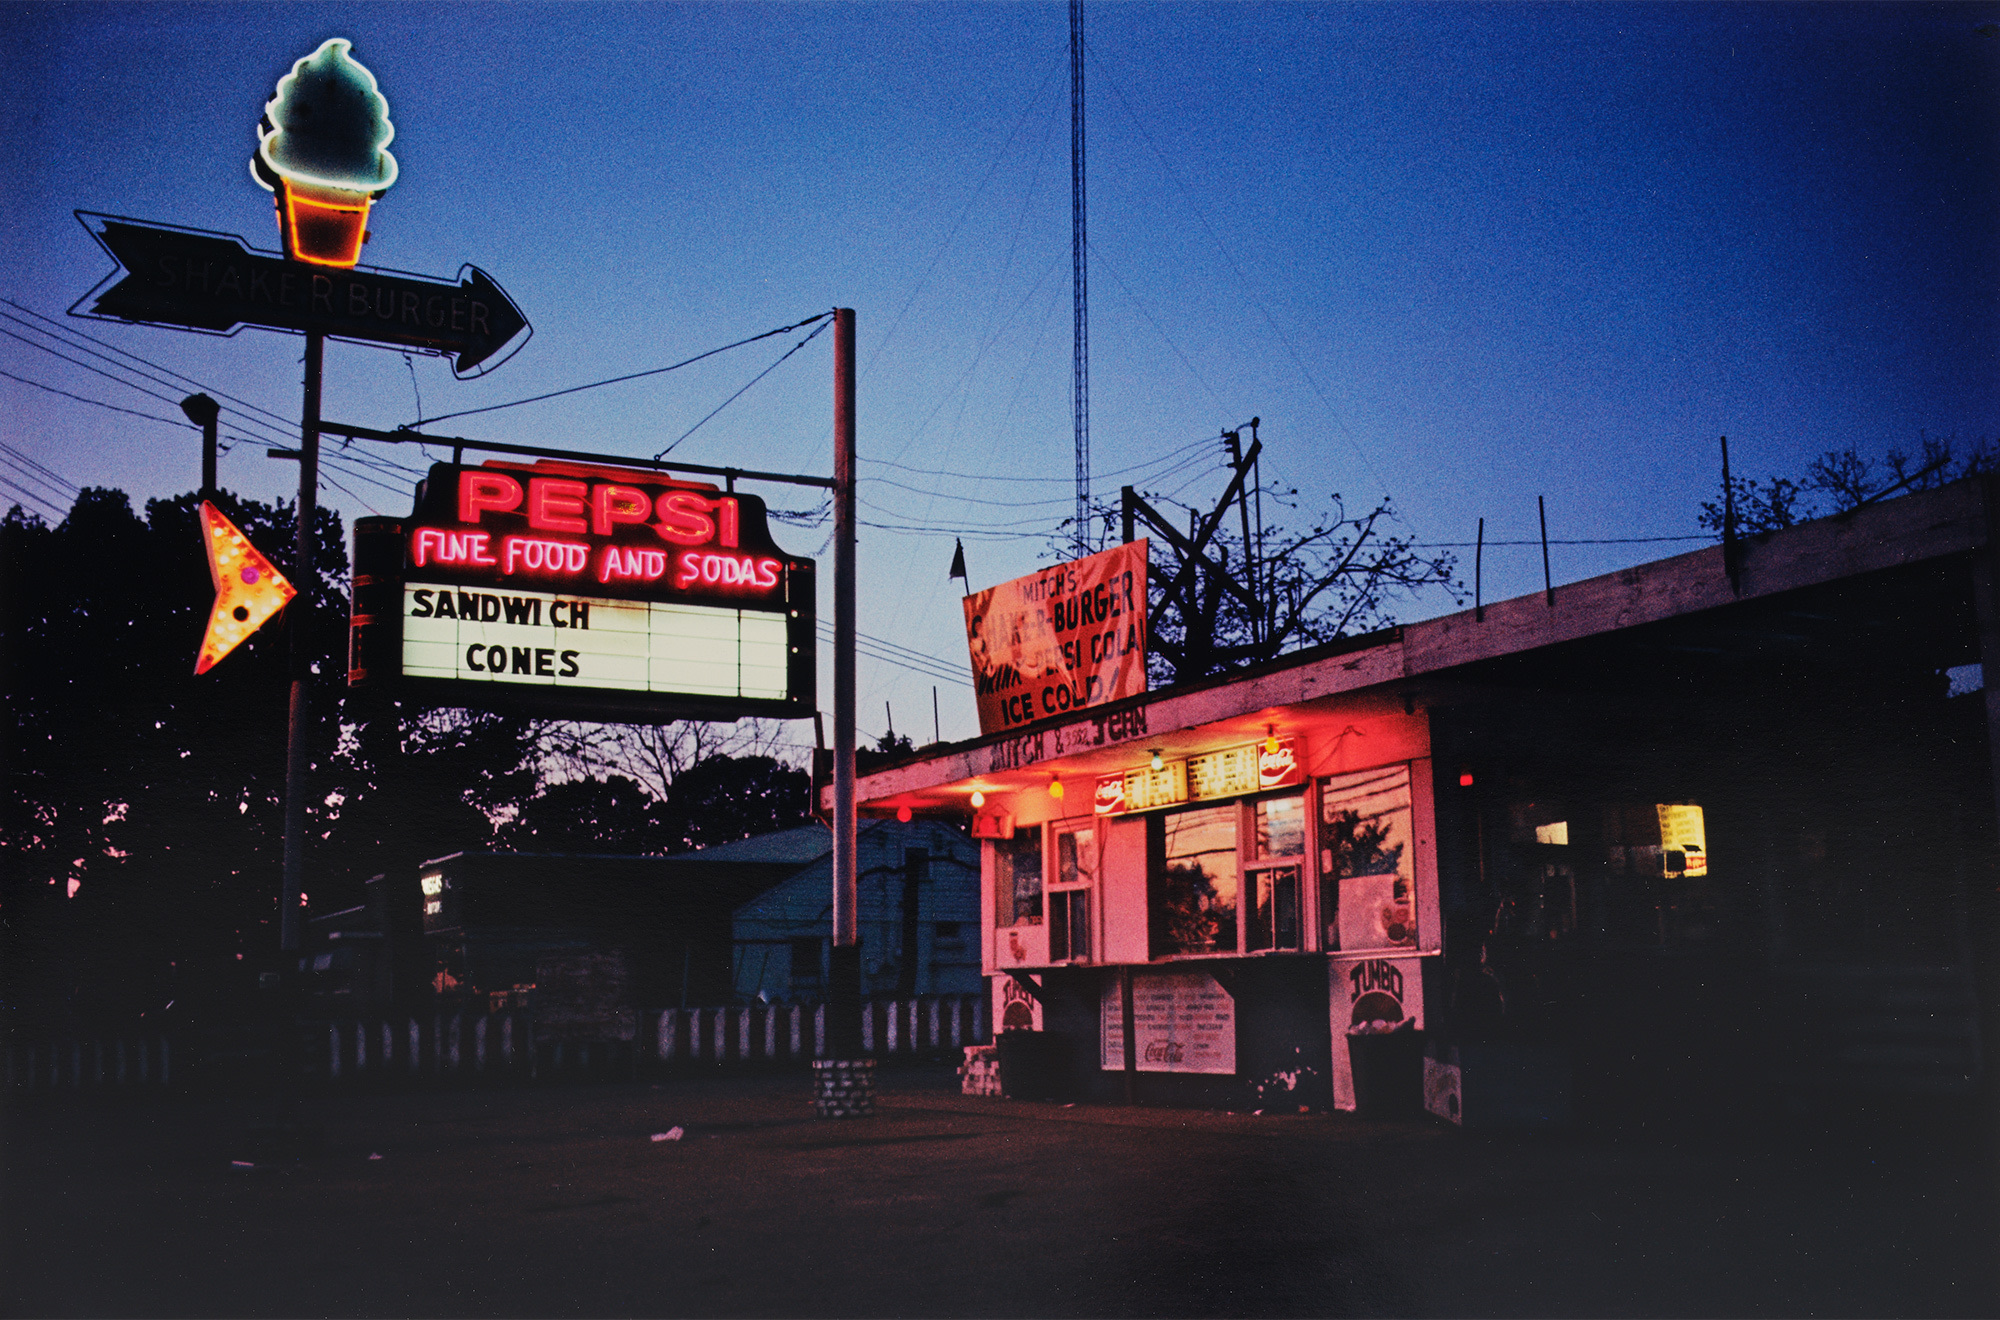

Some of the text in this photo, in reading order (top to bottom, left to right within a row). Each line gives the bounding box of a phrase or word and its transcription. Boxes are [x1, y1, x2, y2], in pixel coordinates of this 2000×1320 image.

[348, 282, 491, 336] BURGER
[457, 471, 739, 548] PEPSI
[414, 529, 782, 588] FINE FOOD AND SODAS
[1022, 566, 1077, 604] MITCH'S
[411, 589, 590, 631] SANDWICH
[466, 643, 580, 678] CONES
[1001, 693, 1034, 726] ICE
[989, 732, 1045, 772] MITCH
[1350, 959, 1404, 1004] JUMBO
